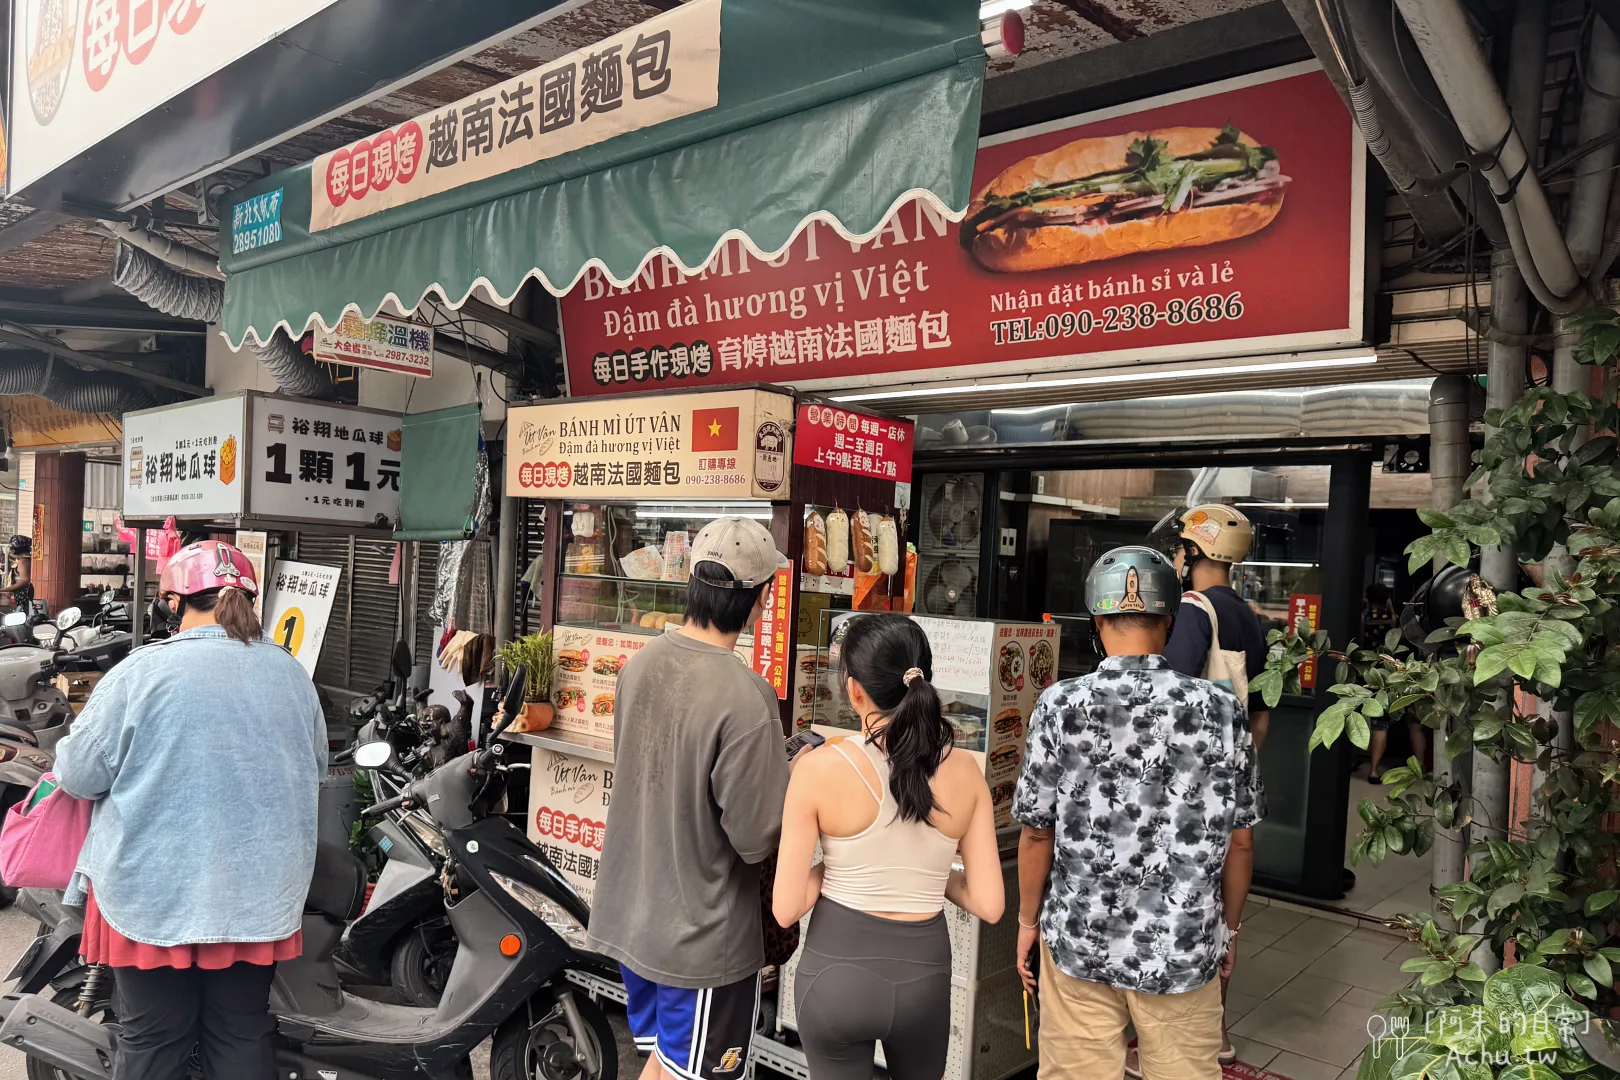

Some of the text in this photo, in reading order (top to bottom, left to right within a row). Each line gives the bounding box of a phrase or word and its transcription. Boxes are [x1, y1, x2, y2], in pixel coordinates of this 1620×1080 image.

[331, 29, 672, 198] 每日現烤 越南法國麵包
[233, 223, 280, 254] 28951080
[603, 259, 930, 342] Đậm đà hương vị Việt
[989, 260, 1235, 314] Nhận đặt bánh sỉ và lẻ
[335, 314, 430, 352] 霧降溫機
[990, 291, 1244, 346] TEL:090-238-8686
[385, 349, 429, 366] 2987-3232
[593, 309, 951, 383] 每日手作現烤 育婷越南法國麵包
[292, 417, 384, 445] 裕翔地瓜球
[559, 410, 682, 437] BÁNH MÌ ÚT VÂN
[810, 407, 905, 442] 營業時間 每週一店休
[559, 437, 681, 457] Đậm đà hương vị Việt
[834, 433, 884, 458] 週二至週日
[146, 449, 216, 484] 裕翔地瓜球
[521, 460, 681, 486] 每日現烤 越南法國麵包
[698, 457, 737, 471] 訂購專線
[814, 446, 897, 478] 上午9點至晚上7點
[685, 474, 746, 485] 090-238-8686
[276, 572, 331, 598] 裕翔地瓜球
[283, 616, 298, 653] 1
[571, 764, 598, 784] Vân
